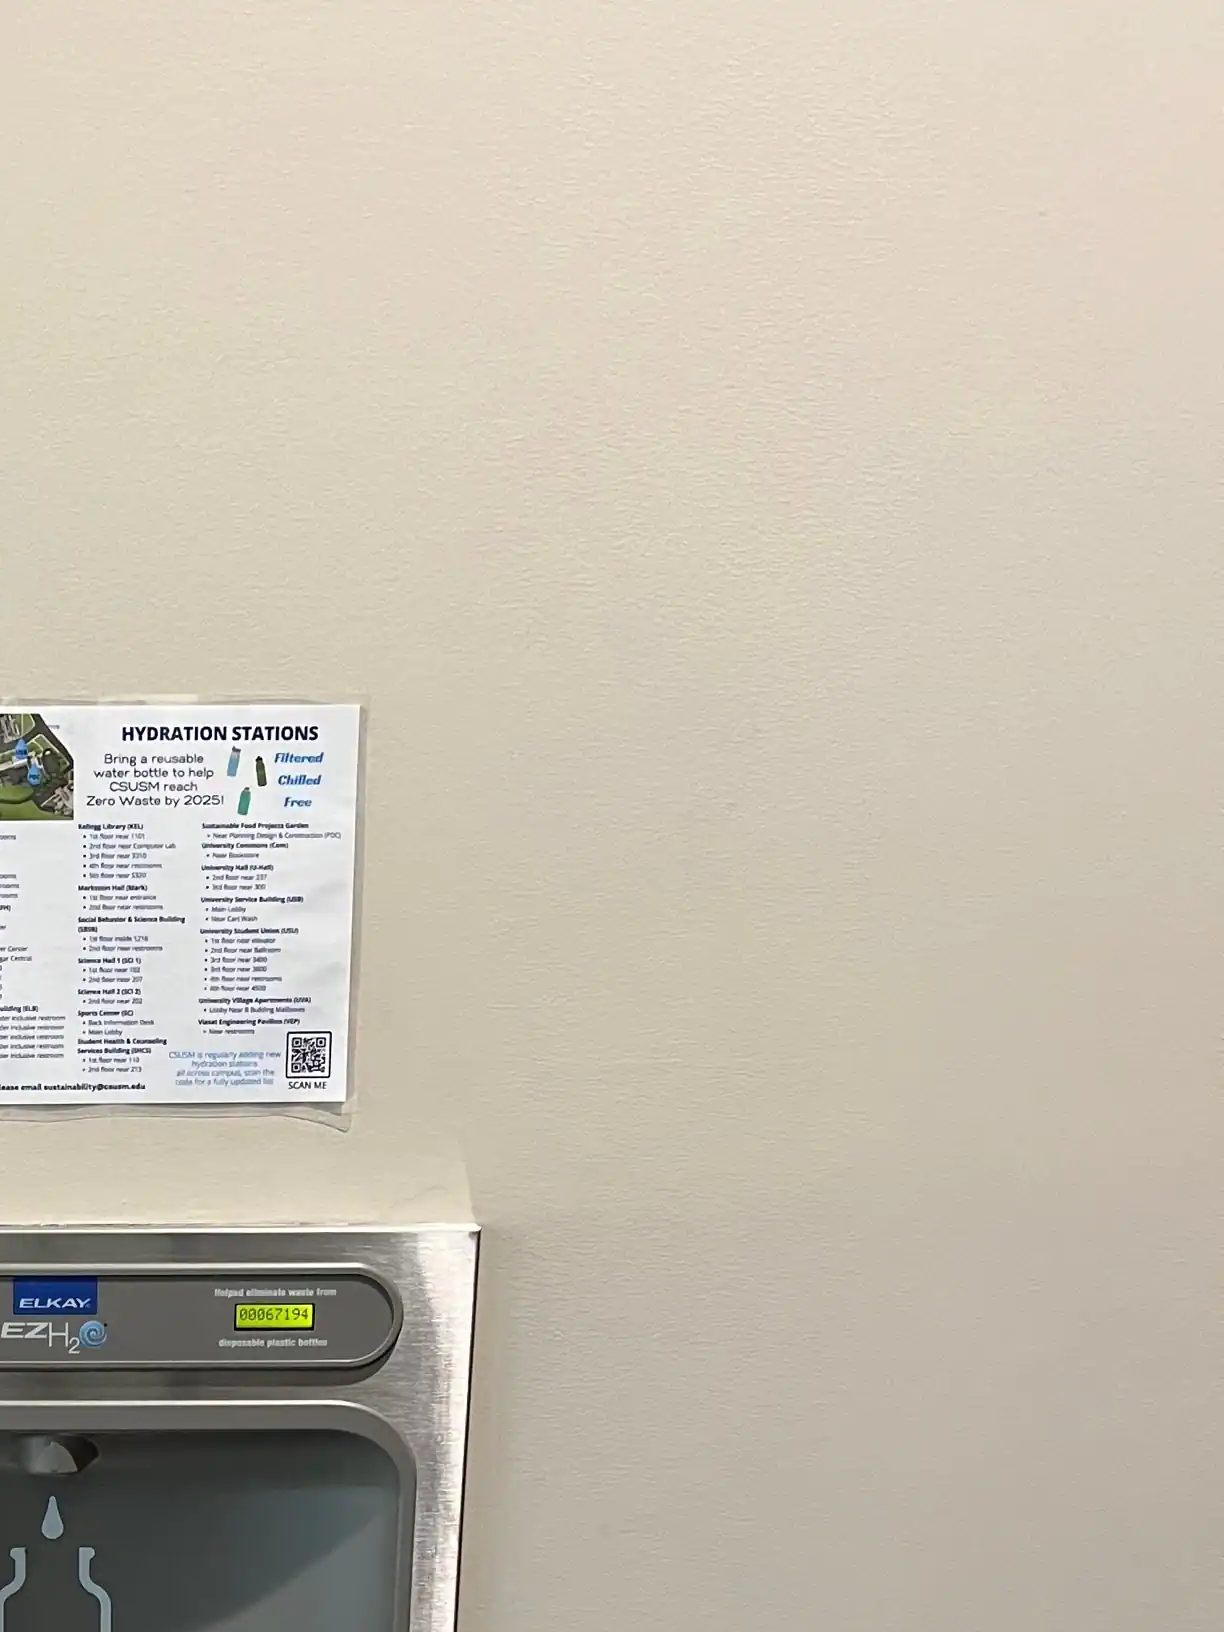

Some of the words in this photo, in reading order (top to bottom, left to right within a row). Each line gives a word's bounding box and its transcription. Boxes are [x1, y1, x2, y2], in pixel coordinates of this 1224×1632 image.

[122, 726, 227, 741] HYDRATION
[232, 726, 319, 741] STATIONS
[104, 754, 136, 766] Bring
[141, 756, 147, 764] a
[152, 754, 204, 764] reusable
[274, 752, 324, 764] Filtered
[94, 769, 130, 778] water
[134, 768, 168, 778] bottle
[173, 769, 185, 778] to
[189, 768, 214, 778] help
[278, 775, 322, 785] Chilled
[110, 782, 160, 792] CSUSM
[164, 782, 197, 792] reach
[86, 795, 115, 806] Zero
[119, 795, 160, 806] Waste
[165, 795, 180, 807] by
[184, 795, 224, 806] 2025!
[284, 797, 312, 807] Free
[205, 1052, 236, 1060] regularly
[239, 1052, 264, 1060] adding
[192, 1060, 227, 1068] hydration
[214, 1078, 229, 1086] fully
[231, 1078, 261, 1086] updated
[44, 1083, 145, 1092] sustainability@csusm.edu
[288, 1288, 314, 1296] waste
[317, 1288, 337, 1296] from
[19, 1298, 91, 1308] ELKAY
[239, 1308, 308, 1321] 00067194
[218, 1338, 264, 1348] disposable
[267, 1338, 296, 1348] plastic
[298, 1338, 328, 1347] bottles
